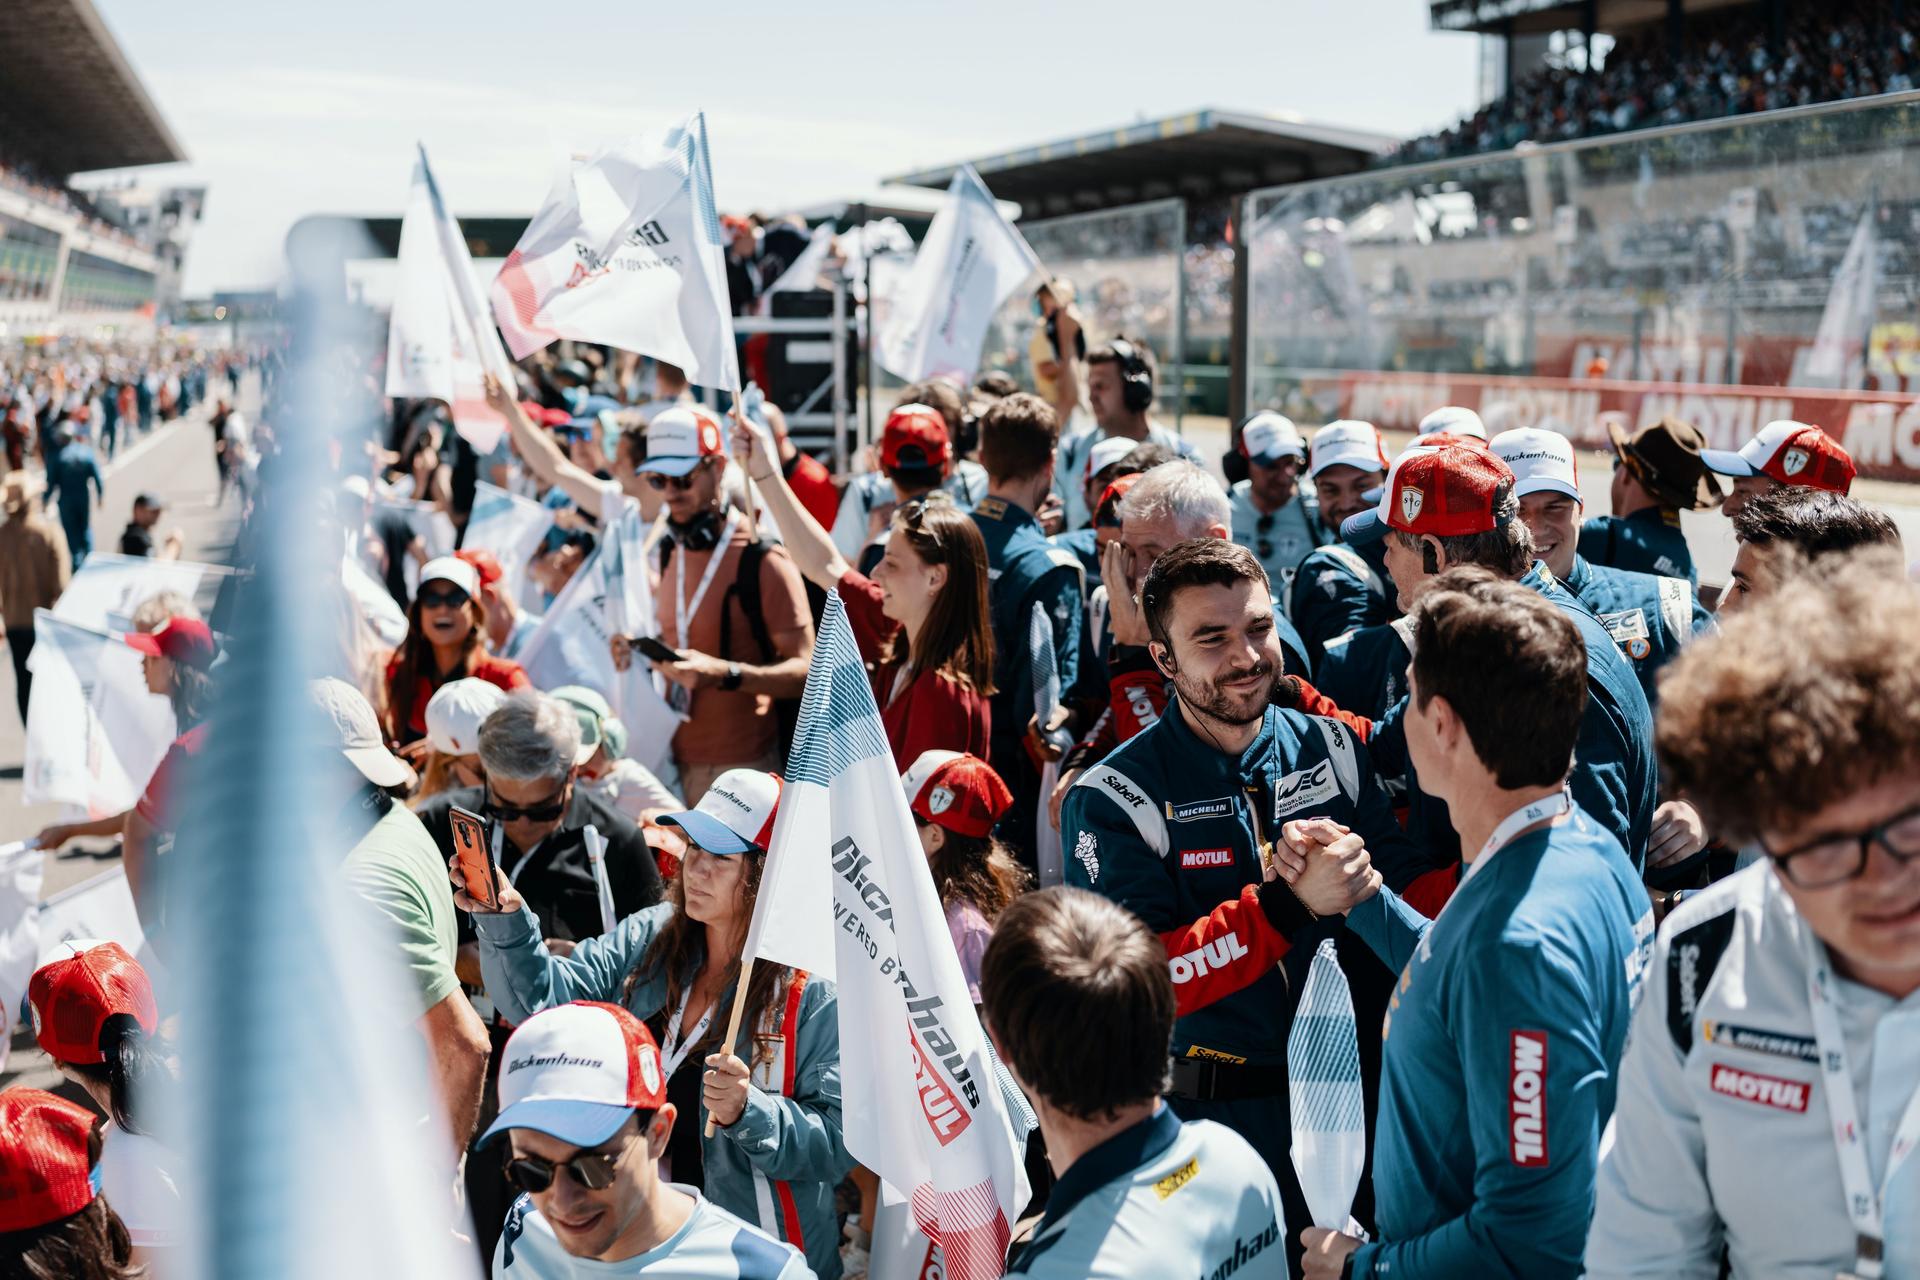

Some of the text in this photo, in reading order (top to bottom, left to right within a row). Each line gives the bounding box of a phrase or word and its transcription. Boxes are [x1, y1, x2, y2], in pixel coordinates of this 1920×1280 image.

[1123, 686, 1160, 727] MOT
[1102, 775, 1147, 808] Sabelt
[1277, 763, 1327, 801] WEC
[1179, 804, 1227, 817] MICHELIN
[1182, 851, 1231, 867] MOTUL
[832, 896, 878, 960] WERED
[1168, 932, 1248, 984] OTUL
[1513, 1034, 1543, 1163] MOTUL
[1713, 1068, 1805, 1110] MOTUL
